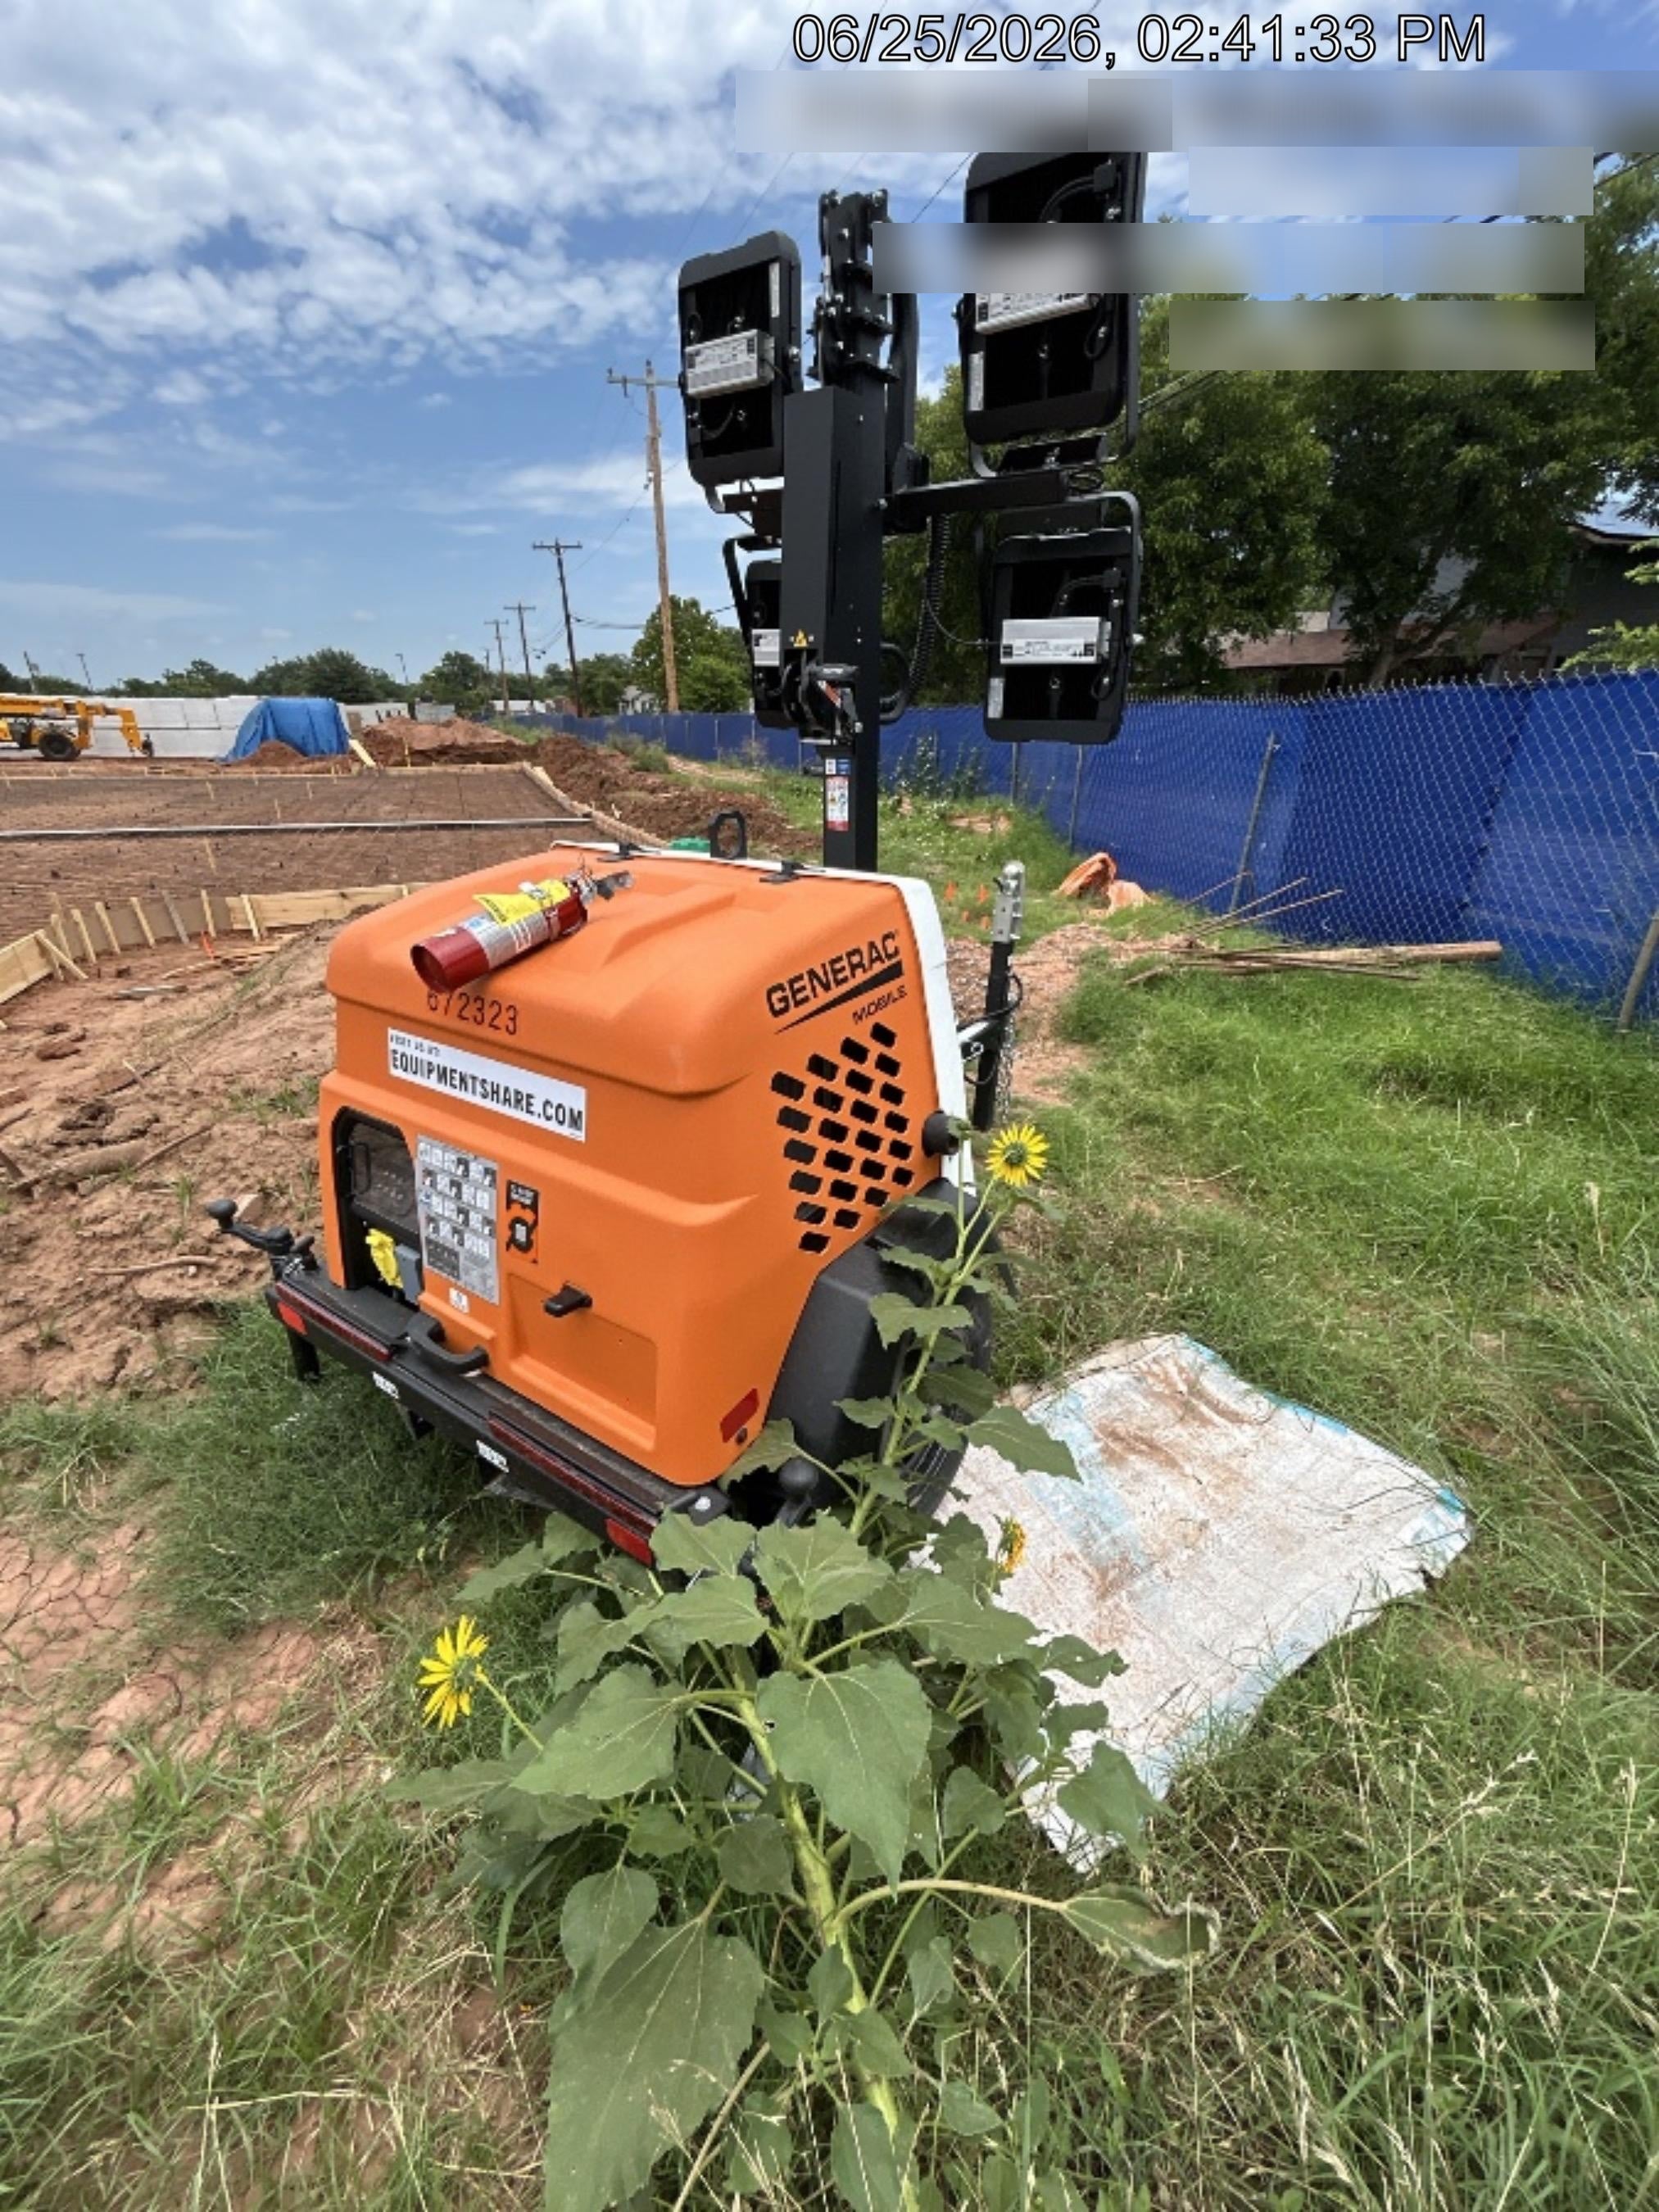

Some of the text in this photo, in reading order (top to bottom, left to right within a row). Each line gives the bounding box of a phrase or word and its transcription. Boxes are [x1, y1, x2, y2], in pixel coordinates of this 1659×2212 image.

[766, 931, 900, 1018] GENERAC
[852, 985, 908, 1024] MOBILE
[427, 990, 518, 1036] 672323
[391, 1049, 583, 1132] EQUIPMENTSHARE.COM
